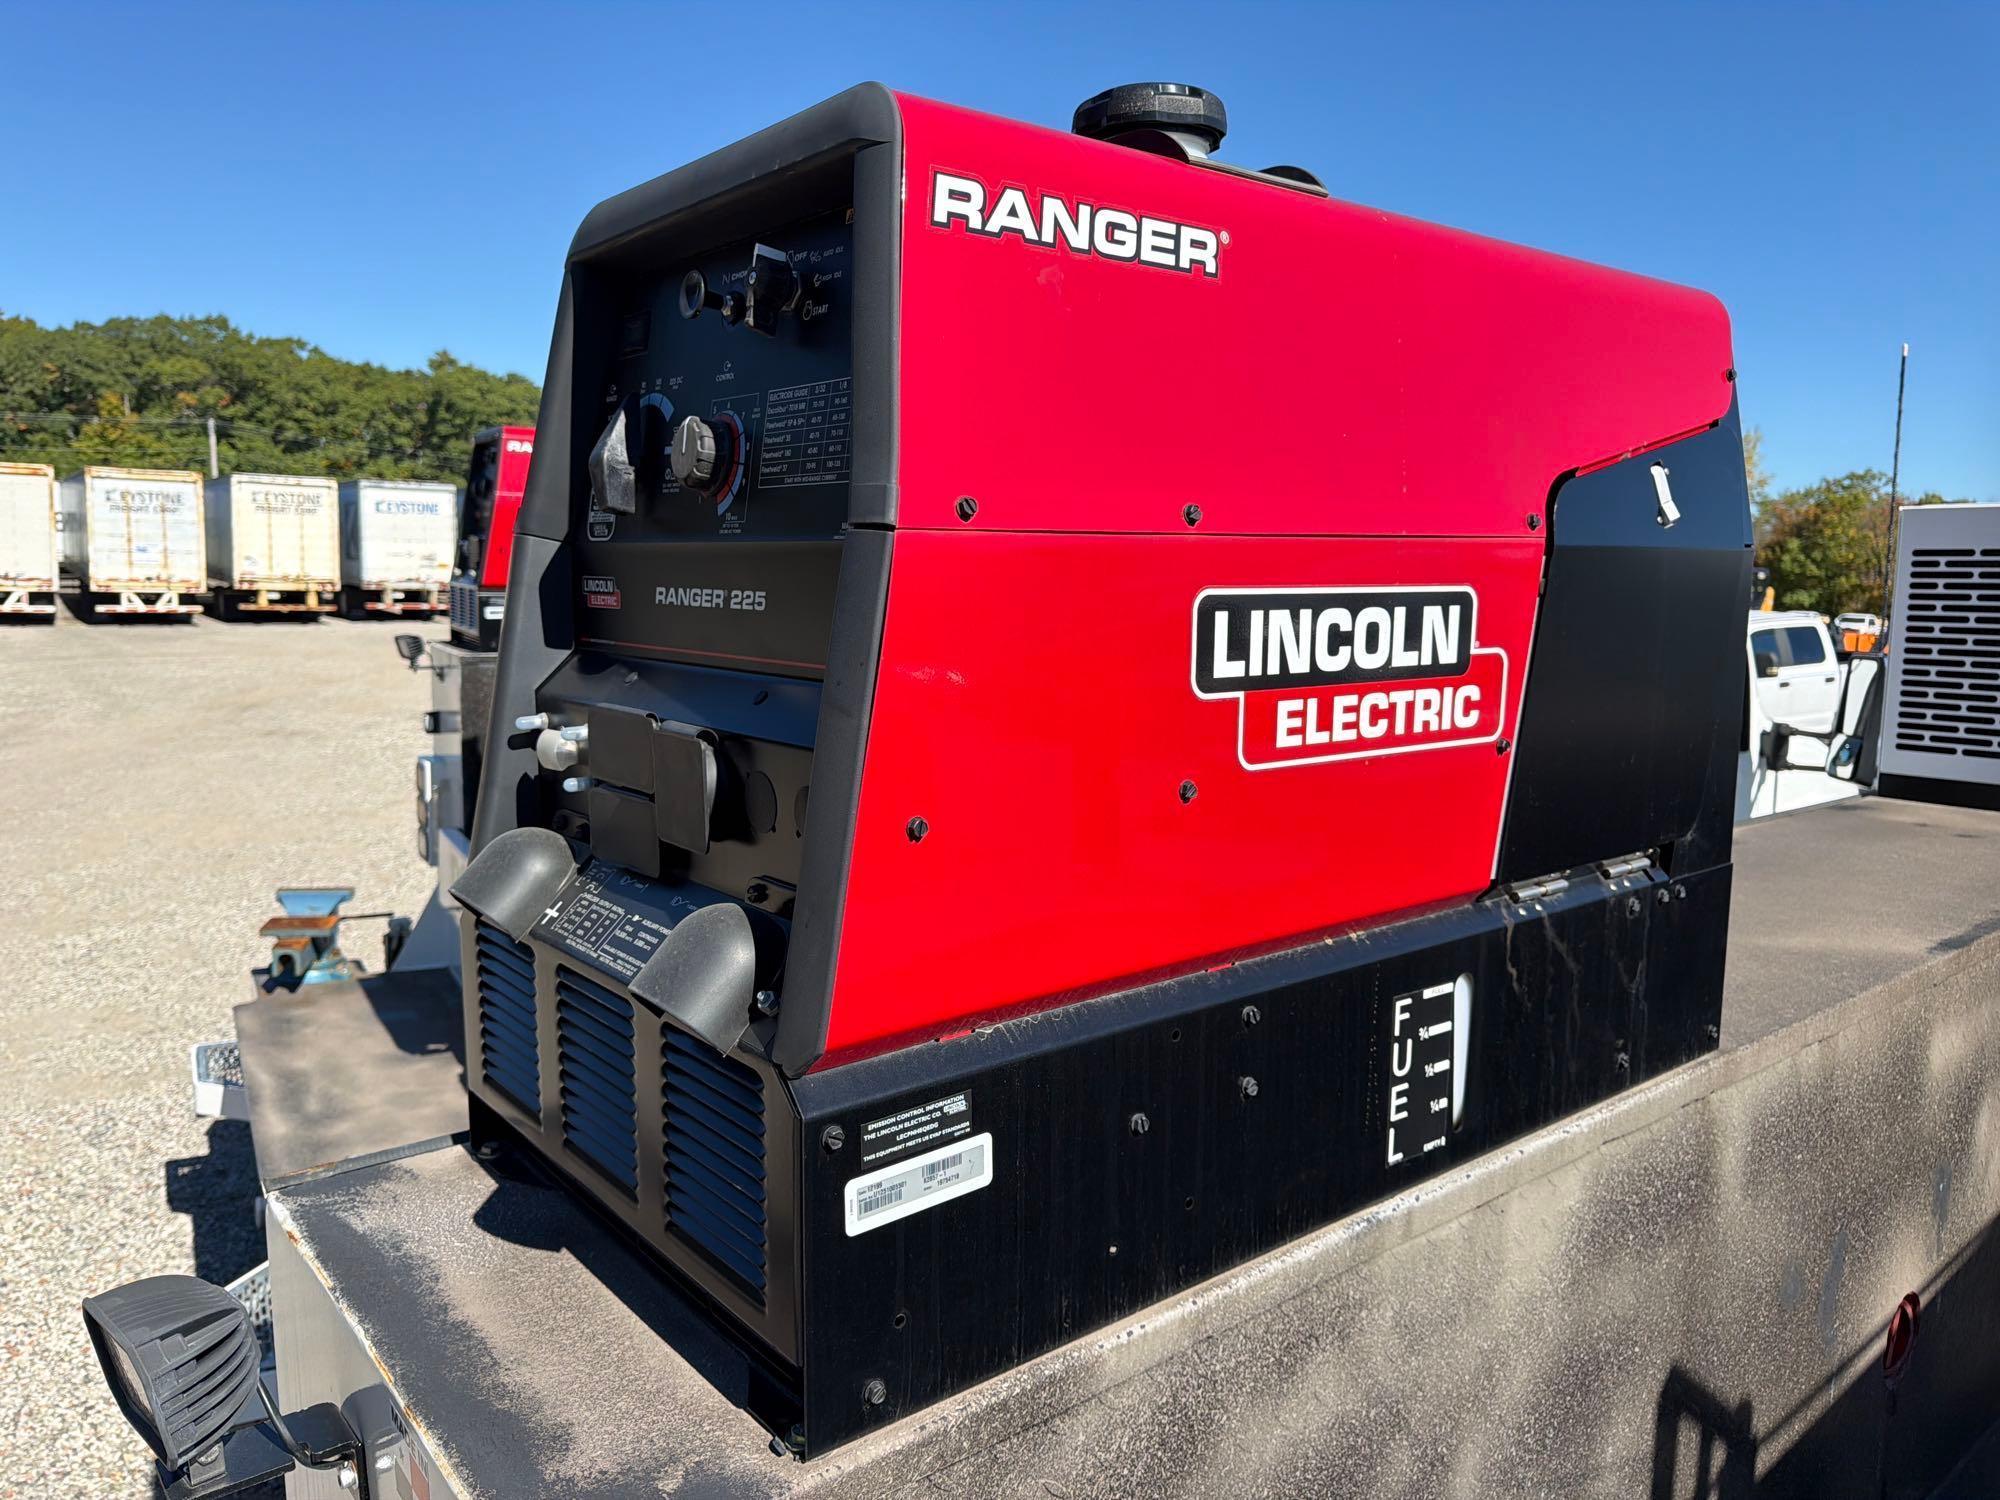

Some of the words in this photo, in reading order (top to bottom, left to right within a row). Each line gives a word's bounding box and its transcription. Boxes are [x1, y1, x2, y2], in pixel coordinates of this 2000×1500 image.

[932, 172, 1218, 276] RANGER
[812, 304, 829, 316] START
[584, 578, 613, 593] LINCOLN
[590, 595, 618, 607] ELECTRIC
[655, 587, 724, 608] RANGER
[729, 590, 767, 611] 225
[1212, 604, 1461, 679] LINCOLN
[1275, 684, 1481, 748] ELECTRIC
[1387, 997, 1413, 1165] FUEL
[863, 1132, 877, 1142] THE
[877, 1123, 904, 1138] LINCOLN
[904, 1114, 931, 1129] ELECTRIC
[868, 1117, 896, 1131] EMISSION
[896, 1107, 926, 1121] CONTROL
[925, 1093, 965, 1111] INFORMATION
